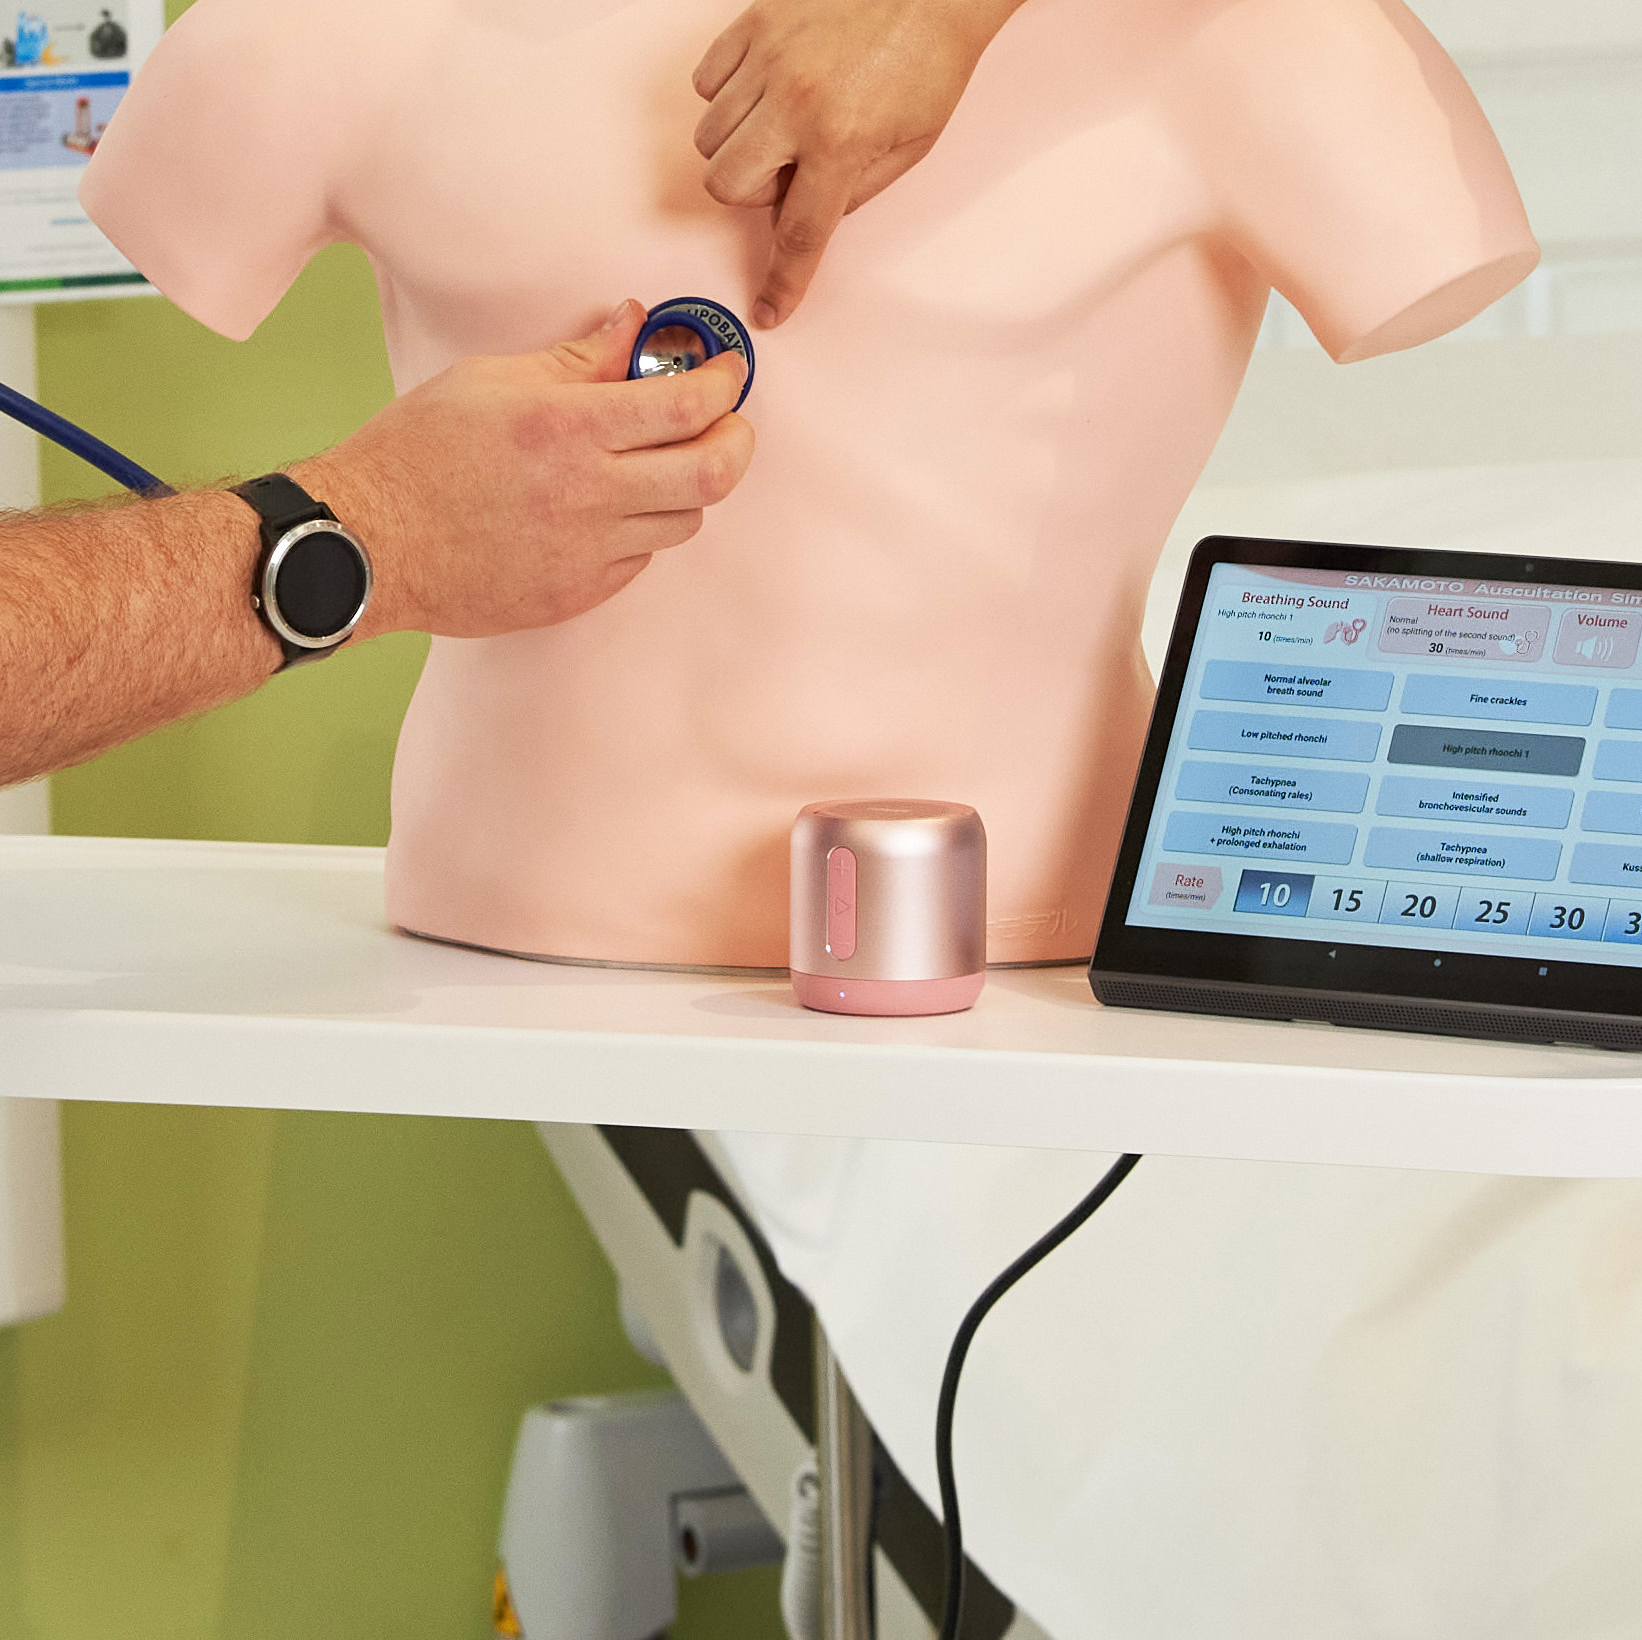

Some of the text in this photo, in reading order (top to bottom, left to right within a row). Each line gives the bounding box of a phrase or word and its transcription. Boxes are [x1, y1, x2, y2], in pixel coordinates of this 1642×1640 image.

[687, 309, 743, 351] IPOBAY
[1344, 574, 1464, 593] SAKAMOTO
[1474, 583, 1602, 603] Auscultation
[1242, 591, 1350, 611] Breathing Sound
[1218, 608, 1235, 620] High
[1237, 609, 1256, 621] pitch
[1258, 610, 1287, 621] rhonchi
[1427, 604, 1510, 621] Heart Sound
[1389, 615, 1418, 625] Normal
[1577, 614, 1628, 629] Volume
[1258, 631, 1272, 643] 10
[1387, 625, 1516, 643] (no splitting of the second sound)
[1429, 642, 1444, 654] 30
[1264, 674, 1332, 687] Normal alveolar
[1267, 686, 1324, 698] breath sound
[1470, 694, 1528, 707] Fine crackles
[1241, 729, 1328, 744] Low pitched rhonchi
[1442, 744, 1463, 755] High
[1464, 745, 1487, 757] pitch
[1488, 746, 1523, 758] rhonchi
[1250, 776, 1297, 789] Tachypnea
[1228, 786, 1313, 801] (Consonating rales)
[1452, 791, 1499, 803] Intensified
[1418, 800, 1527, 817] bronchovesicular sounds
[1221, 826, 1300, 840] High pitch rhonchi
[1216, 838, 1260, 850] prolonged
[1262, 841, 1307, 852] exhalation
[1440, 842, 1487, 855] Tachypnea
[1416, 852, 1506, 869] (shallow respiration)
[1175, 874, 1204, 889] Rate
[1260, 881, 1291, 907] 10
[1331, 888, 1363, 912] 15
[1401, 894, 1437, 918] 20
[1474, 899, 1511, 924] 25
[1549, 905, 1585, 930] 30
